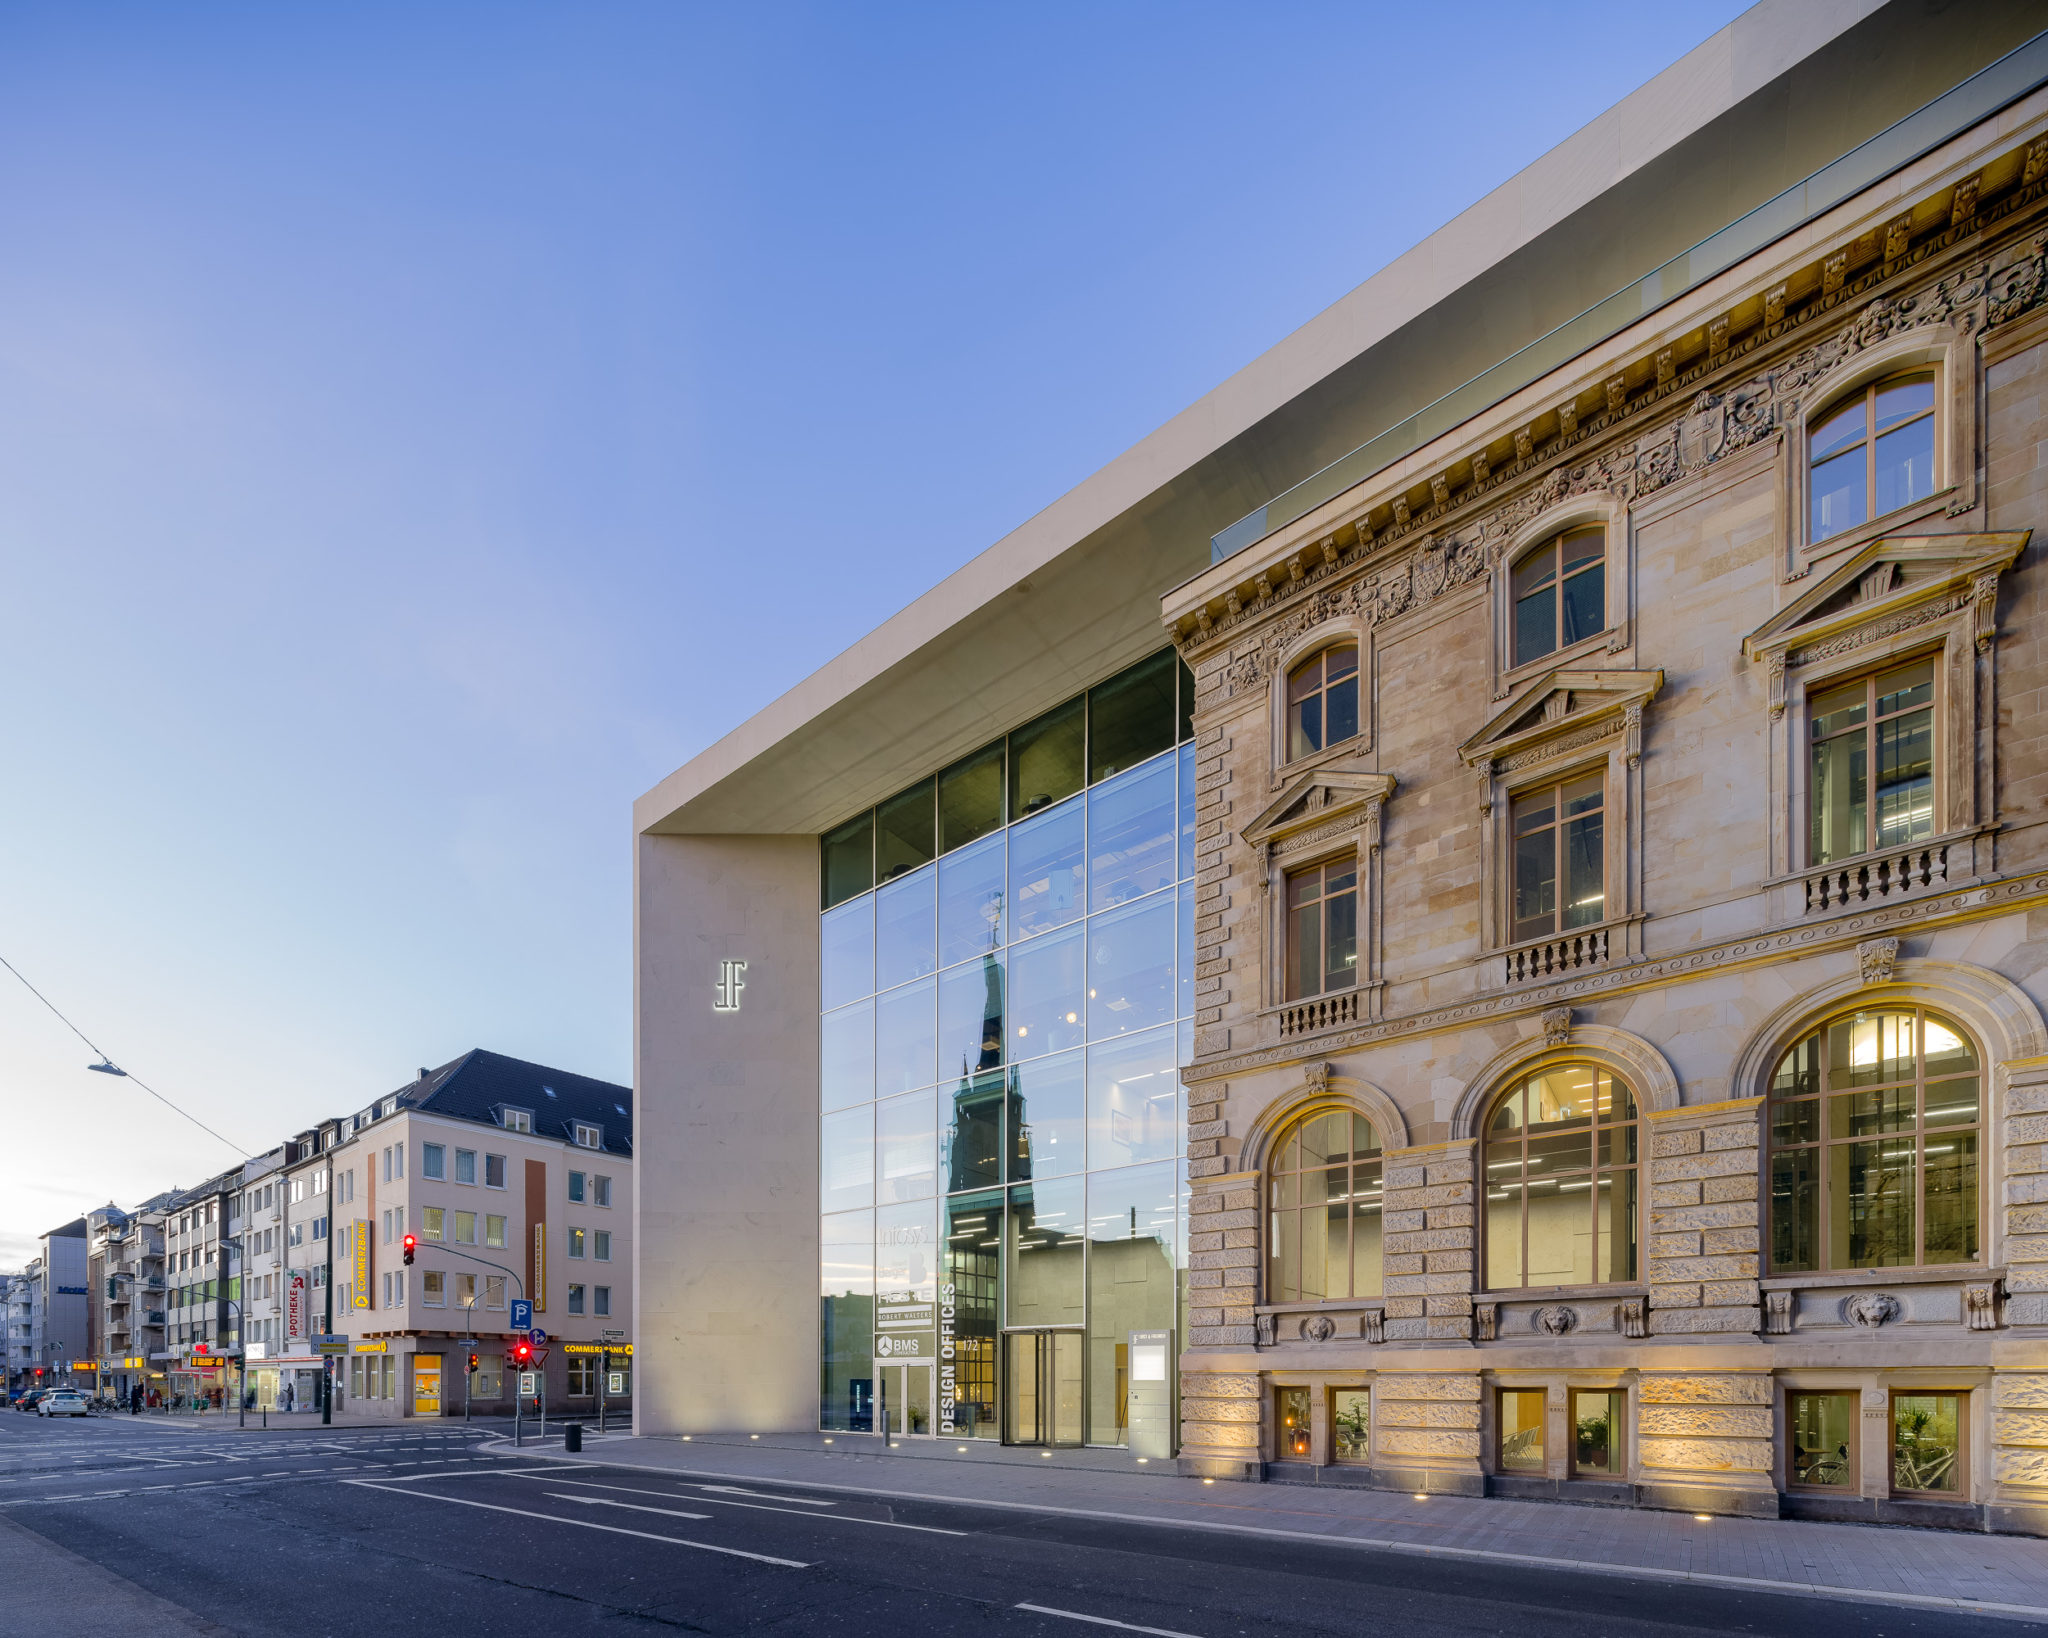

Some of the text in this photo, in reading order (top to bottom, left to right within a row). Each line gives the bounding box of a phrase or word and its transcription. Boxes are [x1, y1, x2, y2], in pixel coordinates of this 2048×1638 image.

[357, 1222, 366, 1292] COMMERZBANK
[290, 1290, 298, 1336] APOTHEKE
[516, 1306, 527, 1321] P
[904, 1311, 932, 1319] WALTERS
[894, 1339, 919, 1351] BMS
[963, 1339, 978, 1351] 172
[941, 1283, 955, 1433] DESIGN OFFICES
